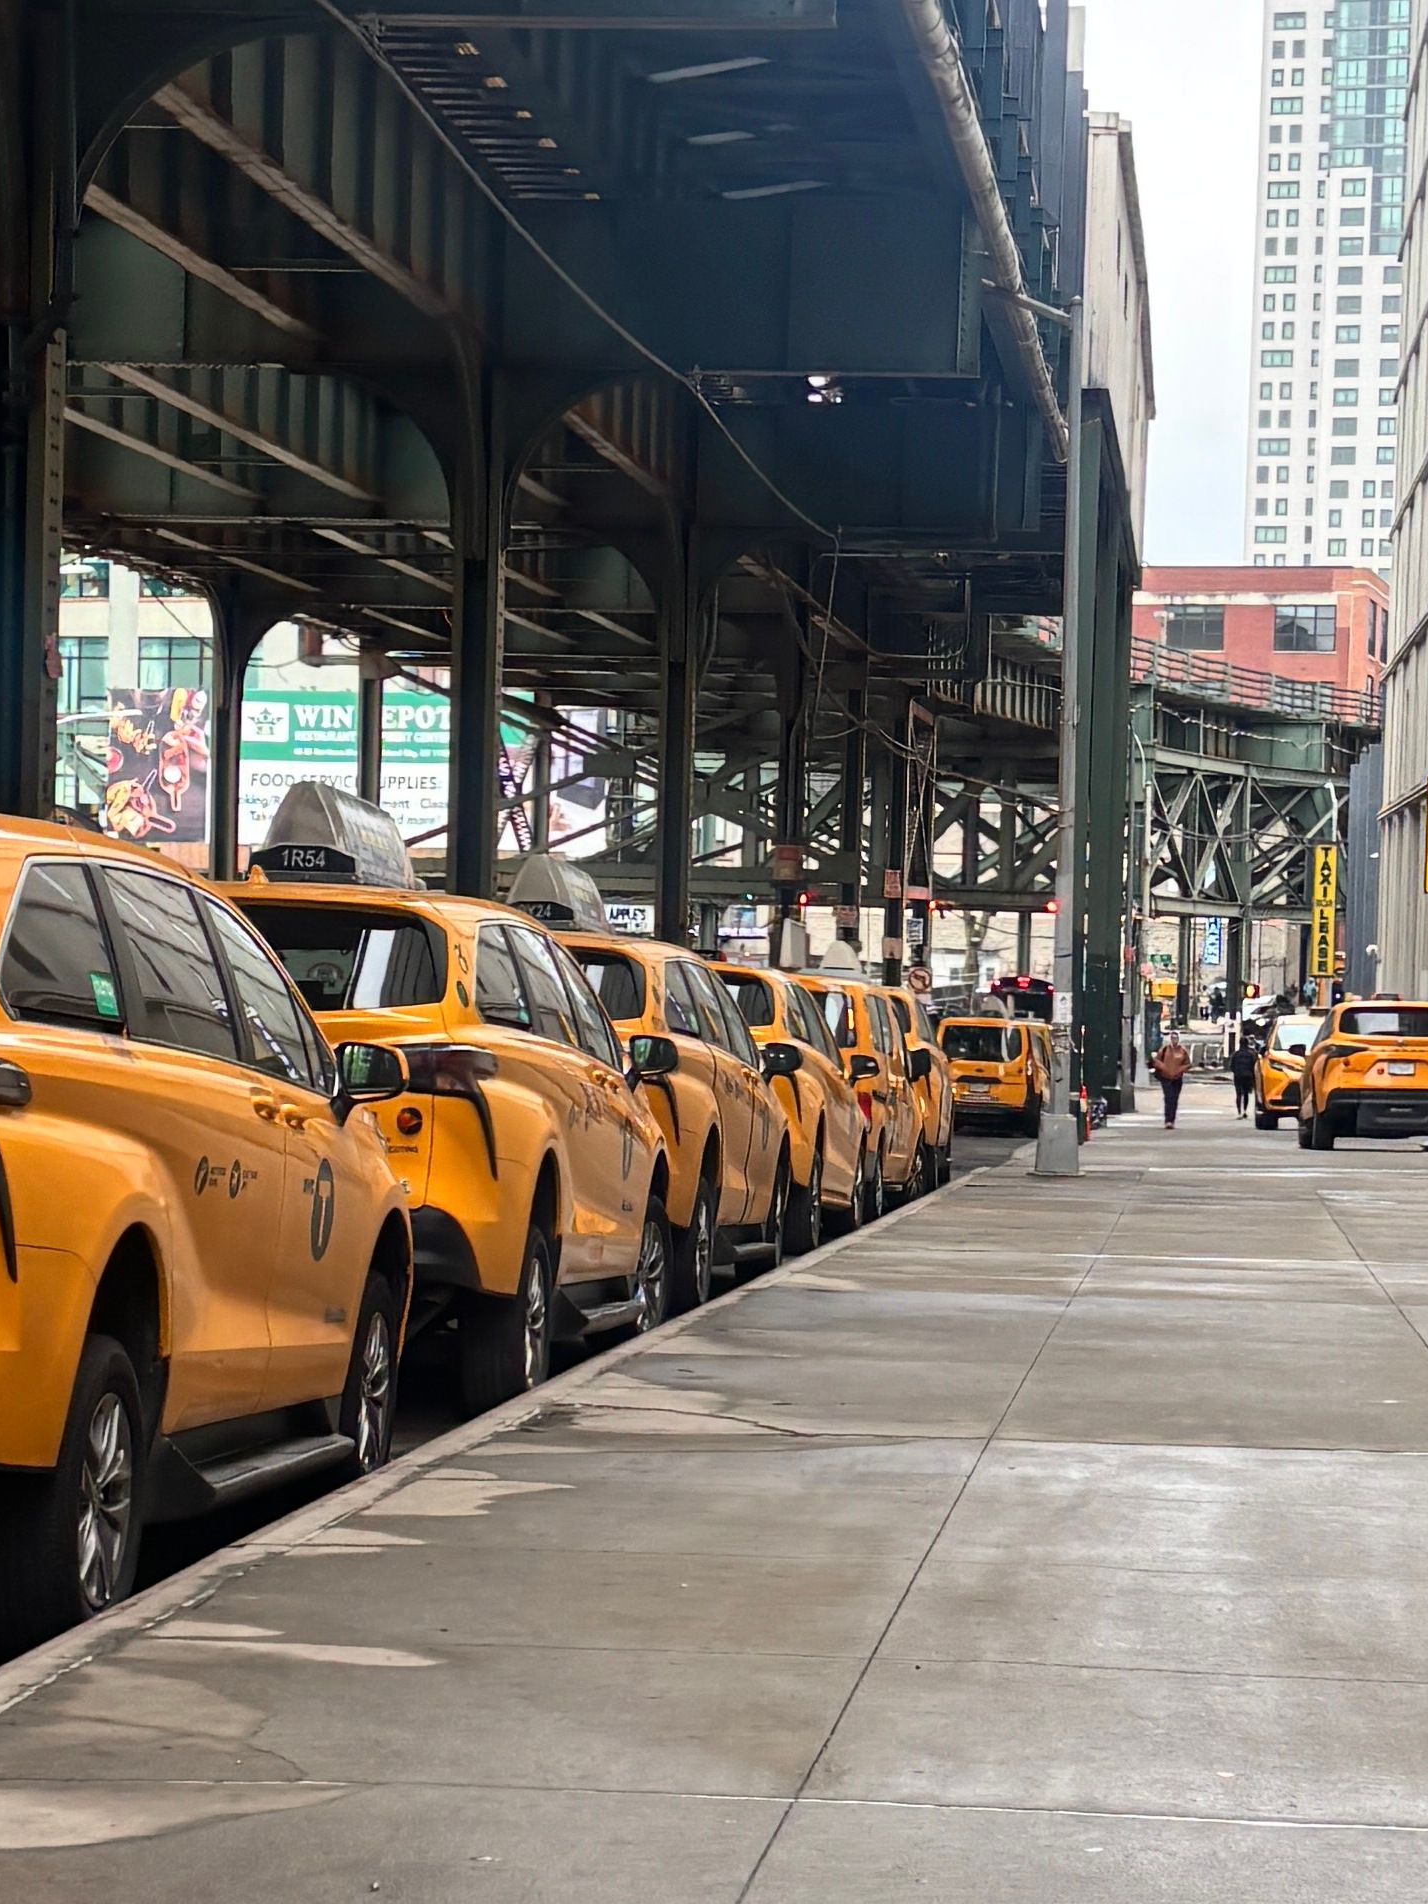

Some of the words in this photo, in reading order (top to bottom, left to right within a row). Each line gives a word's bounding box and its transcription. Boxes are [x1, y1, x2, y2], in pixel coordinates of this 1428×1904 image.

[293, 704, 356, 729] WIN
[382, 704, 450, 730] EPOT
[250, 773, 295, 788] FOOD
[280, 849, 326, 868] 1R54
[1319, 847, 1333, 897] TAXI
[1317, 909, 1329, 973] LEASE
